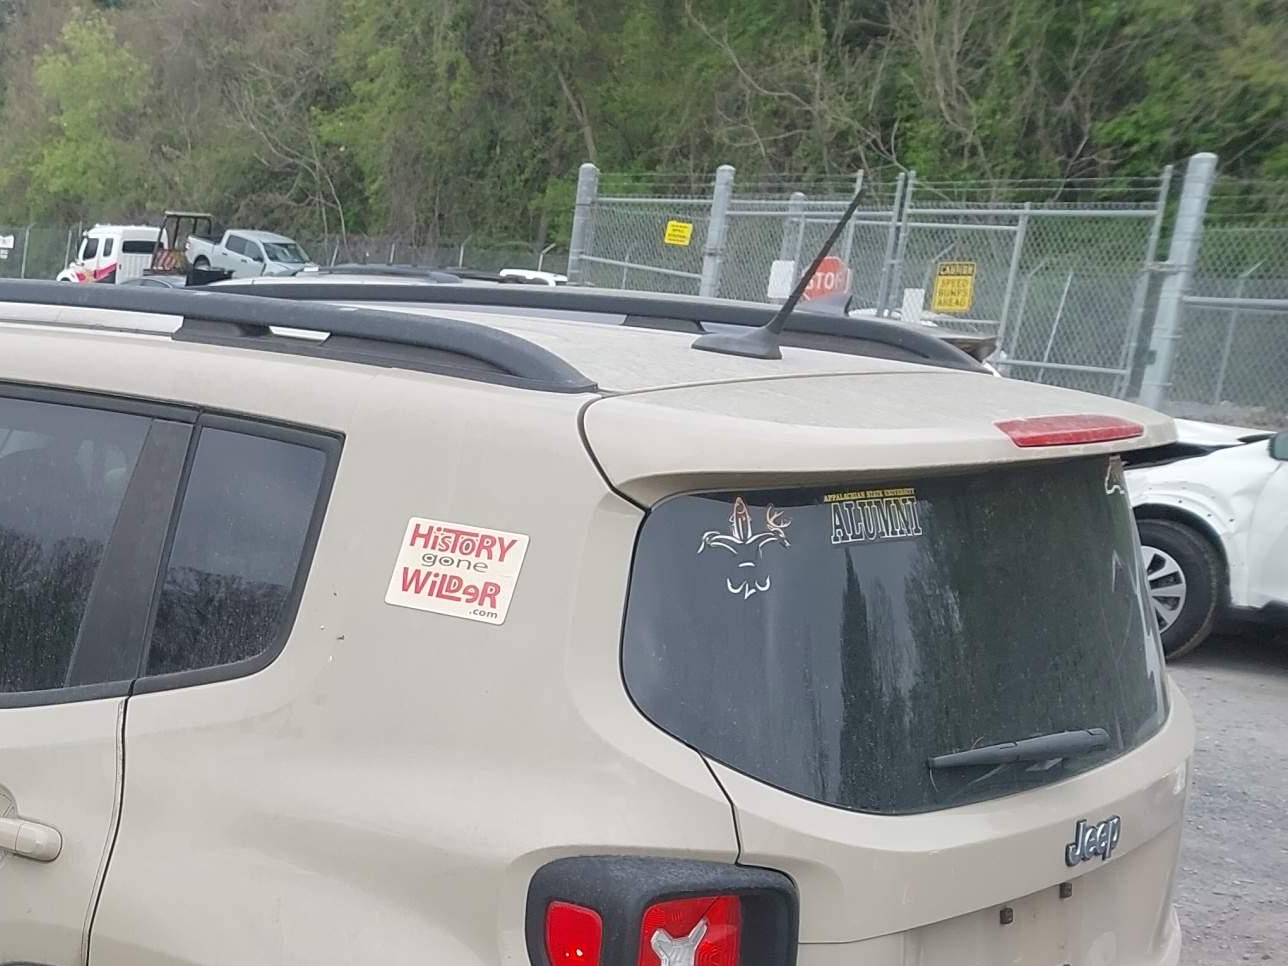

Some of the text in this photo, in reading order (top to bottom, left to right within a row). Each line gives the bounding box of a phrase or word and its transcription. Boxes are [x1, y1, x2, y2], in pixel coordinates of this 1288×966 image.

[831, 497, 922, 544] ALUMNI
[421, 552, 489, 573] gone
[469, 608, 498, 619] .com
[1065, 815, 1120, 867] Jeep
